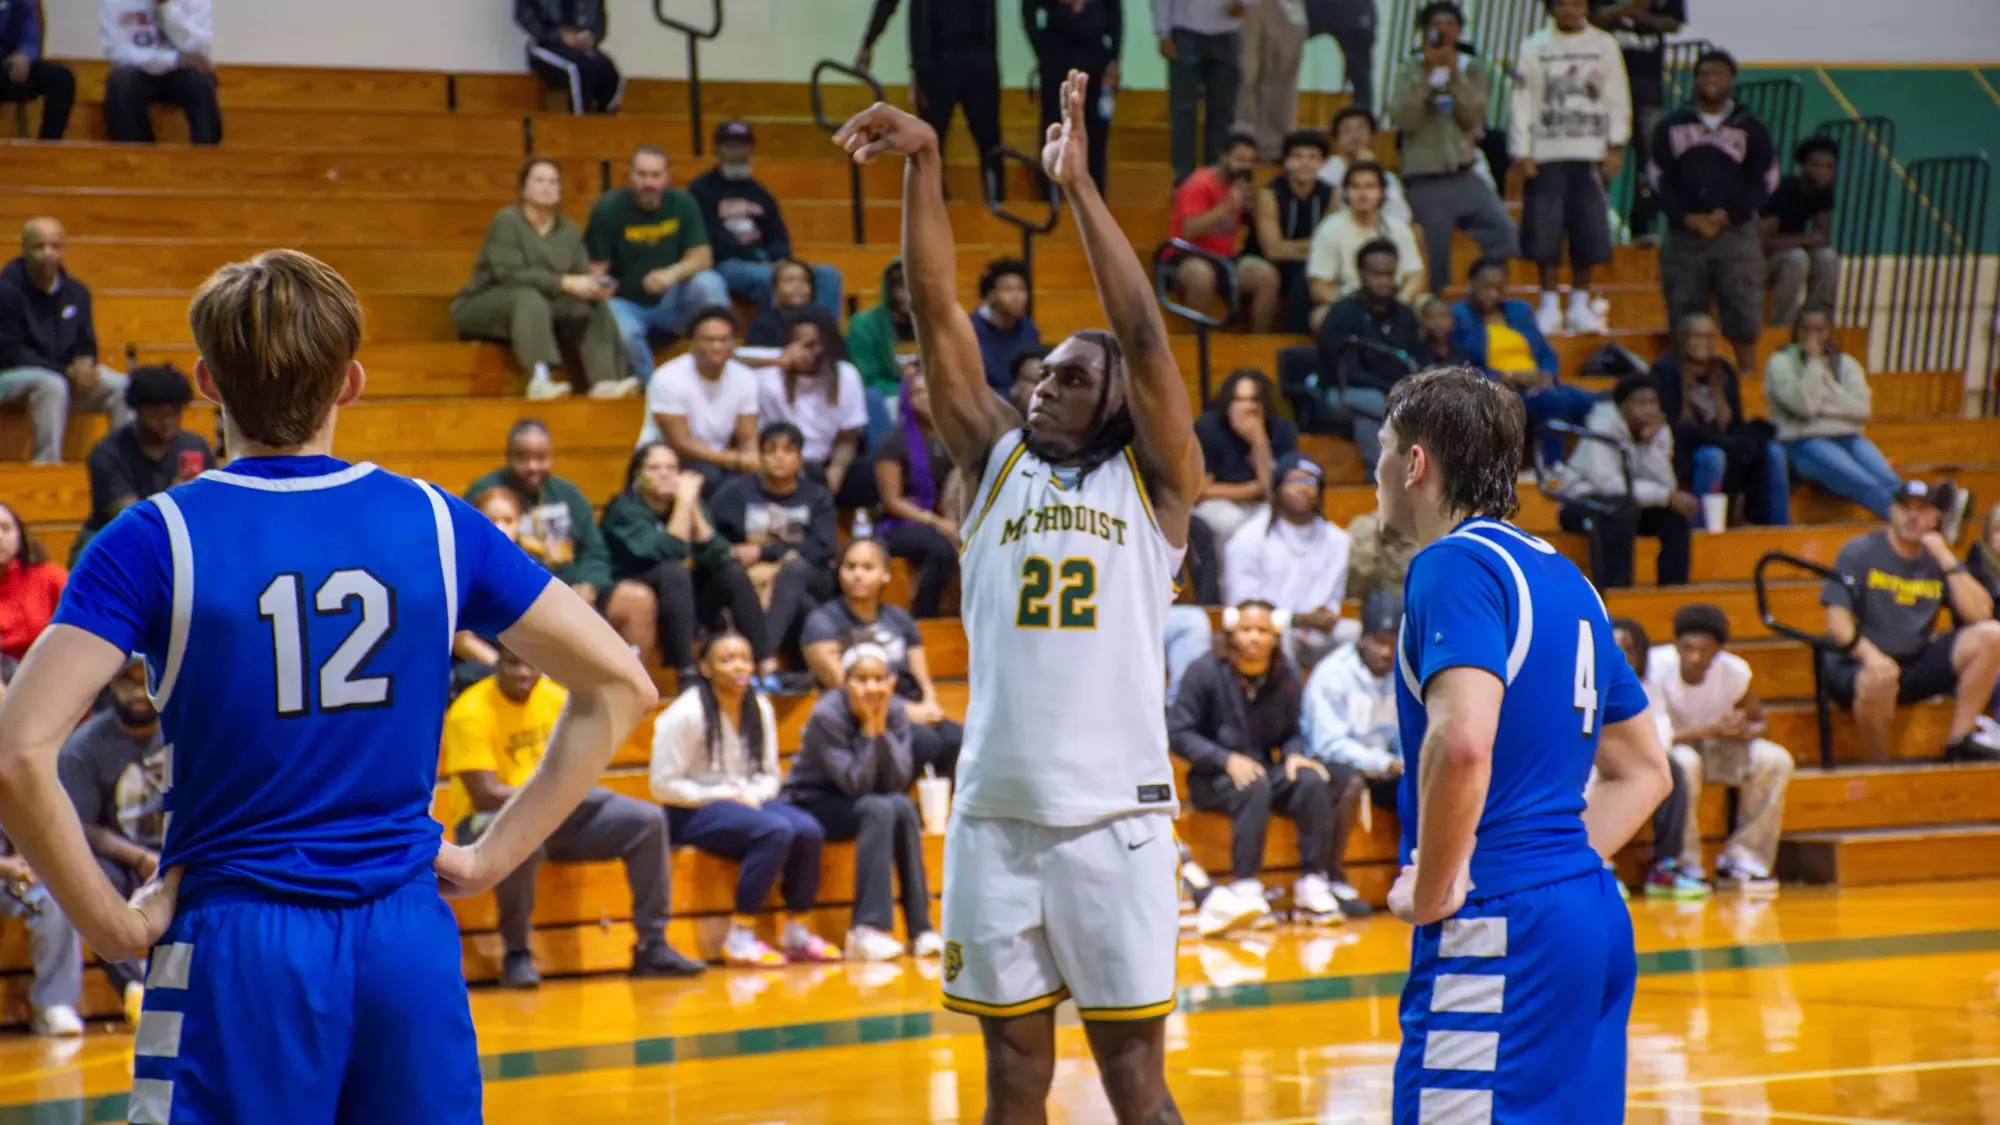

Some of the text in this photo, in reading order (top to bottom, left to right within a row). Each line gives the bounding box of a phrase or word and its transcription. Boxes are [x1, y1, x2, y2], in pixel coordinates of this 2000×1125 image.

[999, 504, 1127, 546] MTHODIST
[1015, 556, 1098, 630] 22
[258, 567, 397, 718] 12
[1573, 617, 1598, 737] 4
